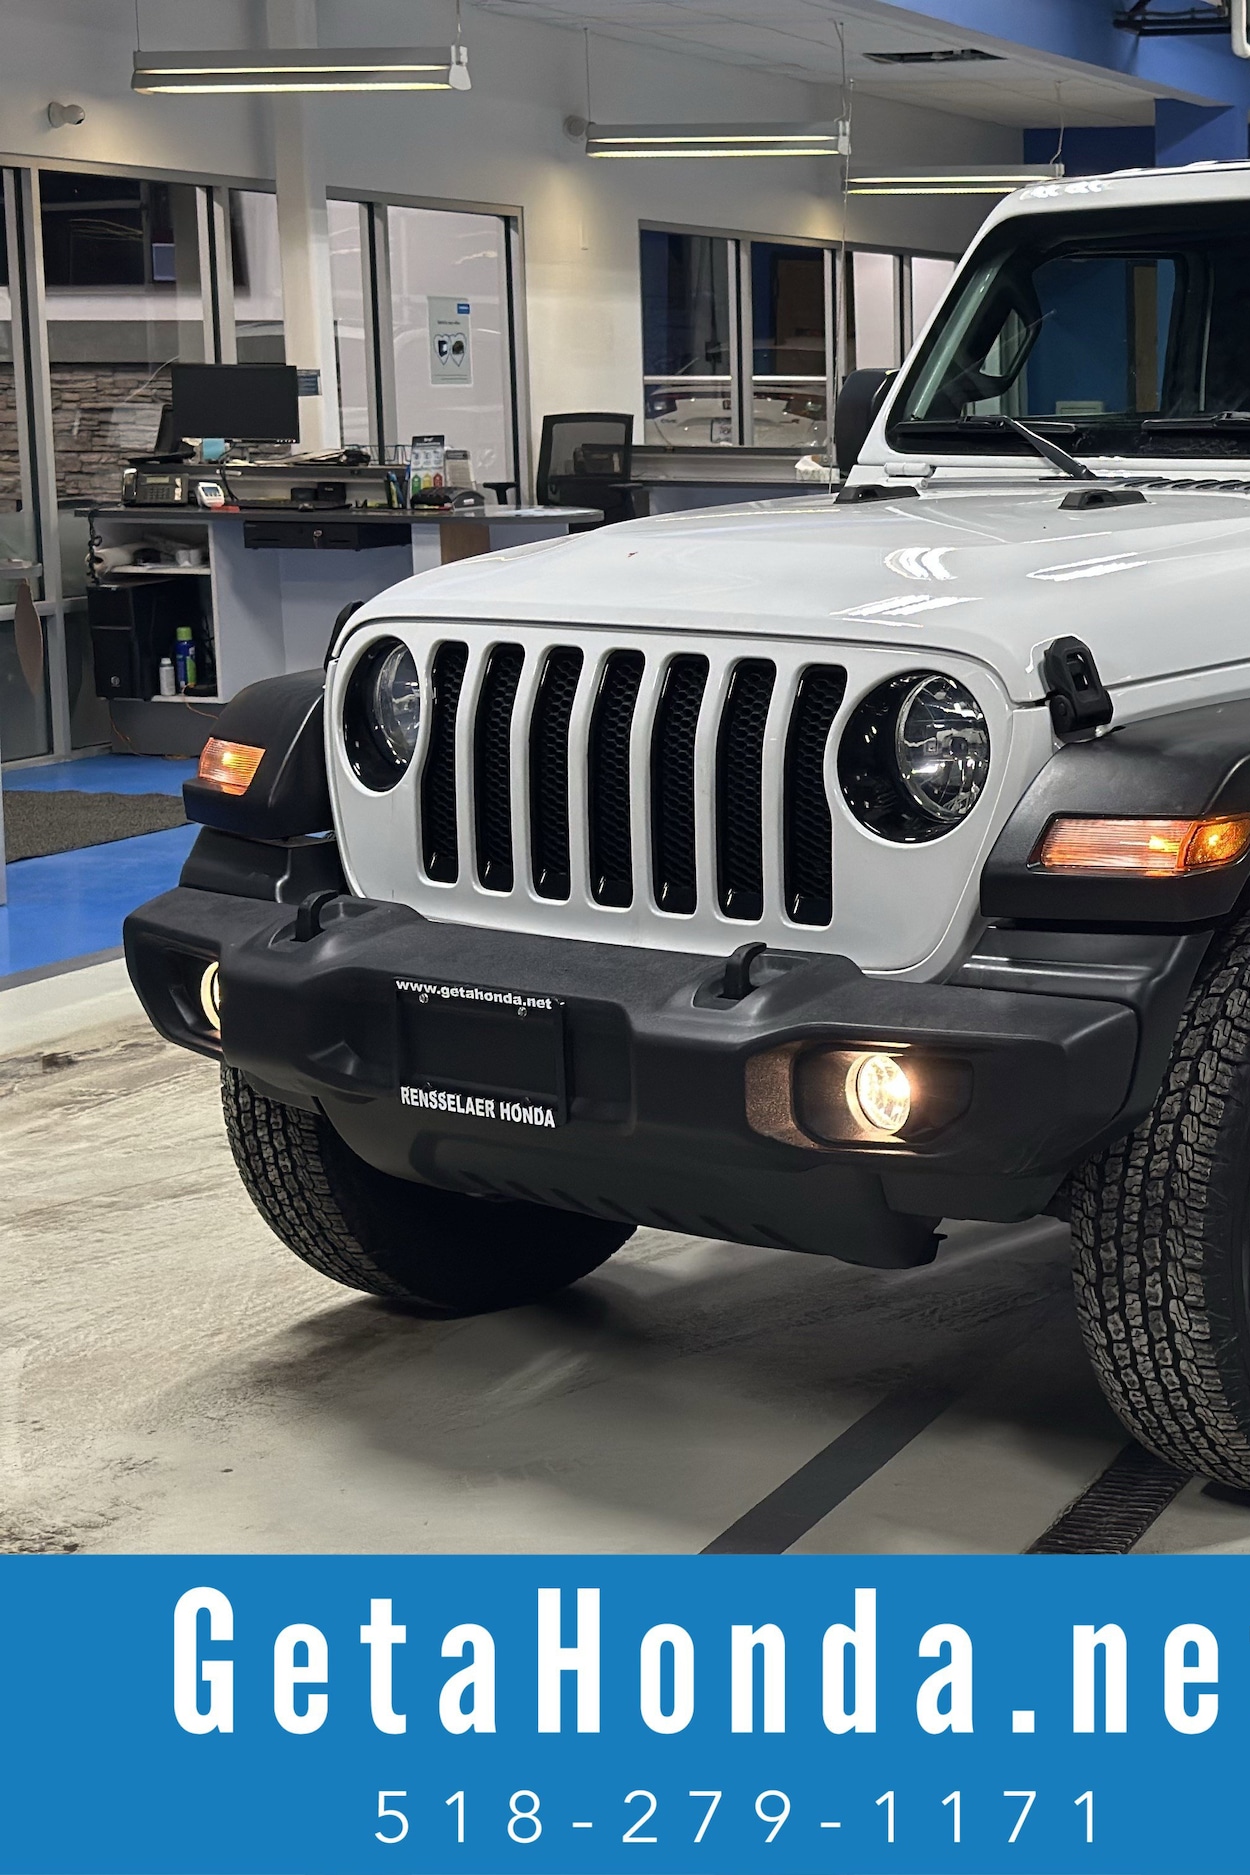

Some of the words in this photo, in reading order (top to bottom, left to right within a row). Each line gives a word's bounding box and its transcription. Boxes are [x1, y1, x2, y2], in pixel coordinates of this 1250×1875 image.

[396, 980, 552, 1010] www.getahonda.net
[400, 1086, 496, 1119] RENSSELAER
[500, 1101, 556, 1128] HONDA
